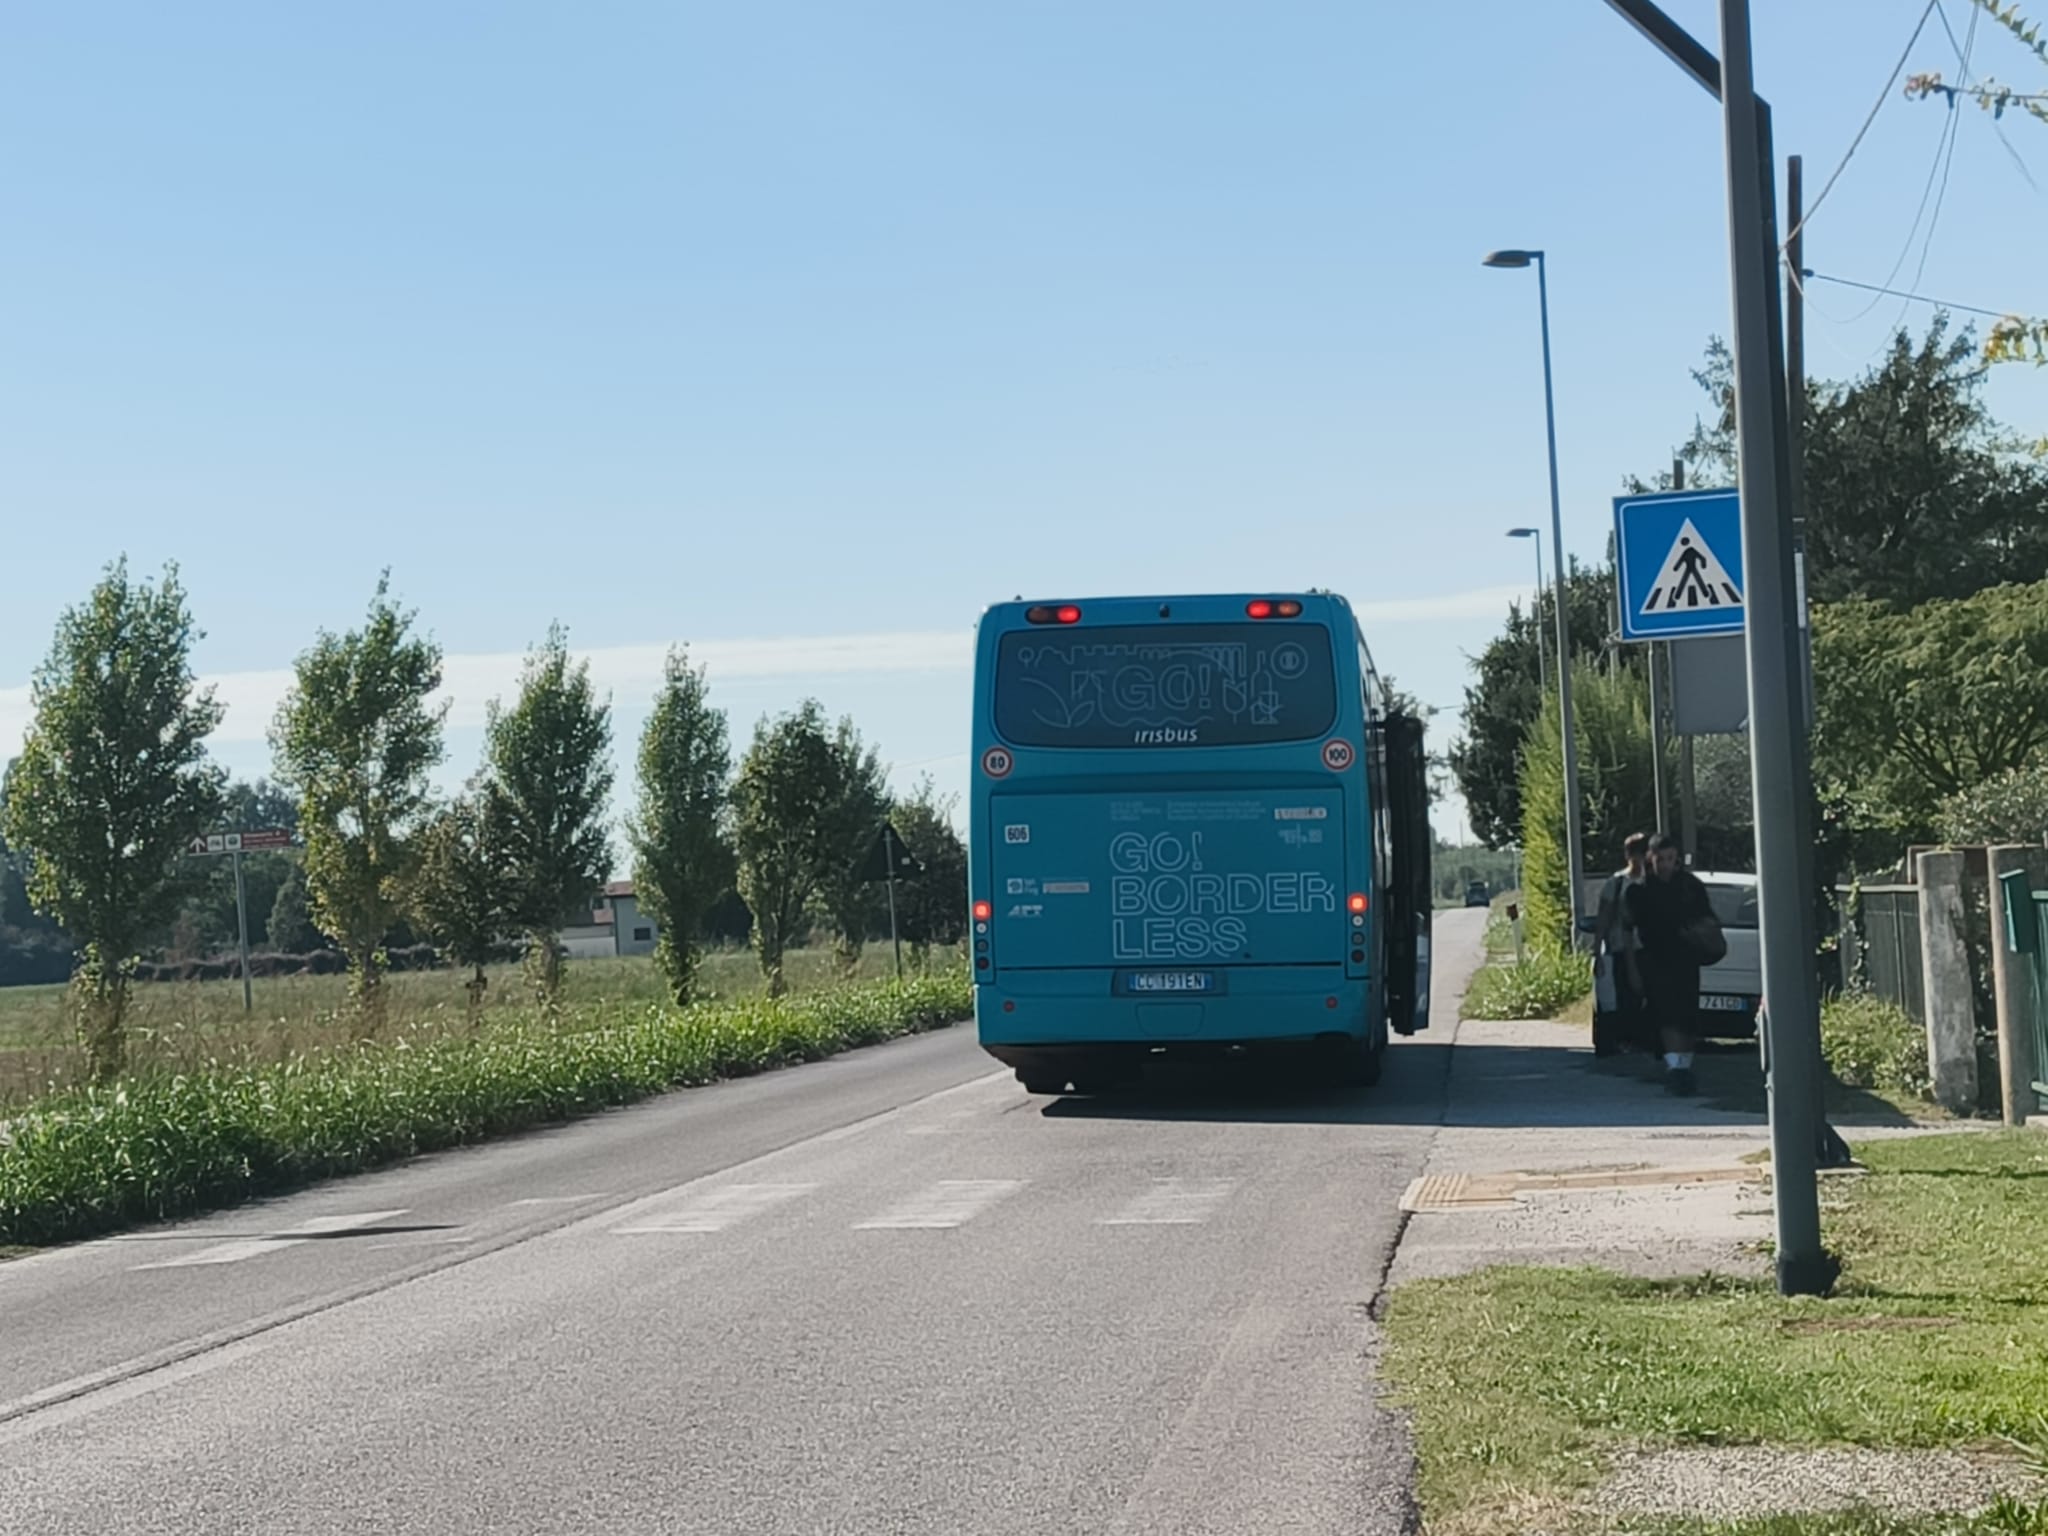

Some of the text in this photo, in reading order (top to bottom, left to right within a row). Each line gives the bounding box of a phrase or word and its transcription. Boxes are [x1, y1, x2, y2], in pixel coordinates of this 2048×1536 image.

[1134, 727, 1199, 744] irisbus
[990, 756, 1006, 770] 80
[1329, 748, 1348, 763] 100
[1007, 828, 1028, 842] 606
[1110, 831, 1203, 873] GO!
[1111, 872, 1335, 916] BORDER
[1112, 917, 1248, 959] LESS
